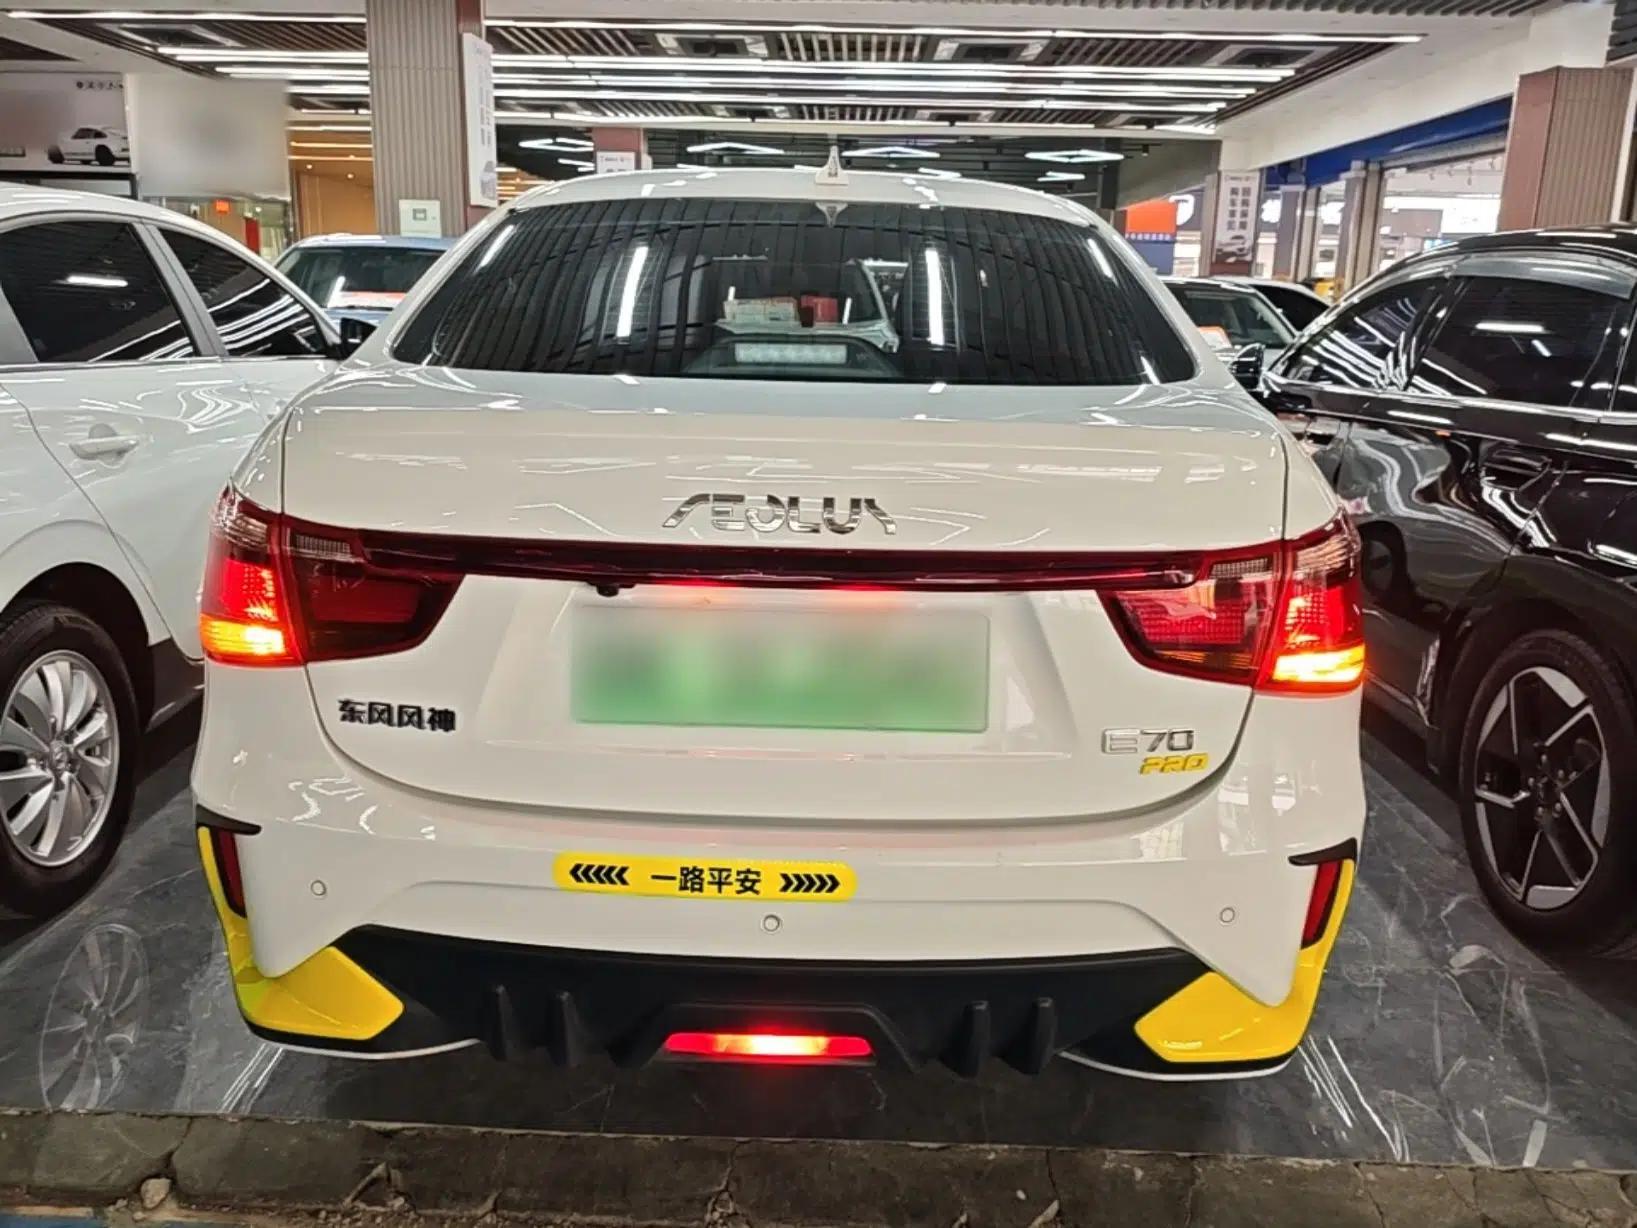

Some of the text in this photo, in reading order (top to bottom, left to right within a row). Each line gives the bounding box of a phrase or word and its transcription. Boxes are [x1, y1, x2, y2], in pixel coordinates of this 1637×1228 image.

[338, 698, 456, 732] 东风风神
[1101, 728, 1195, 754] E70
[1139, 753, 1208, 775] PRO
[651, 865, 762, 895] 一路平安
